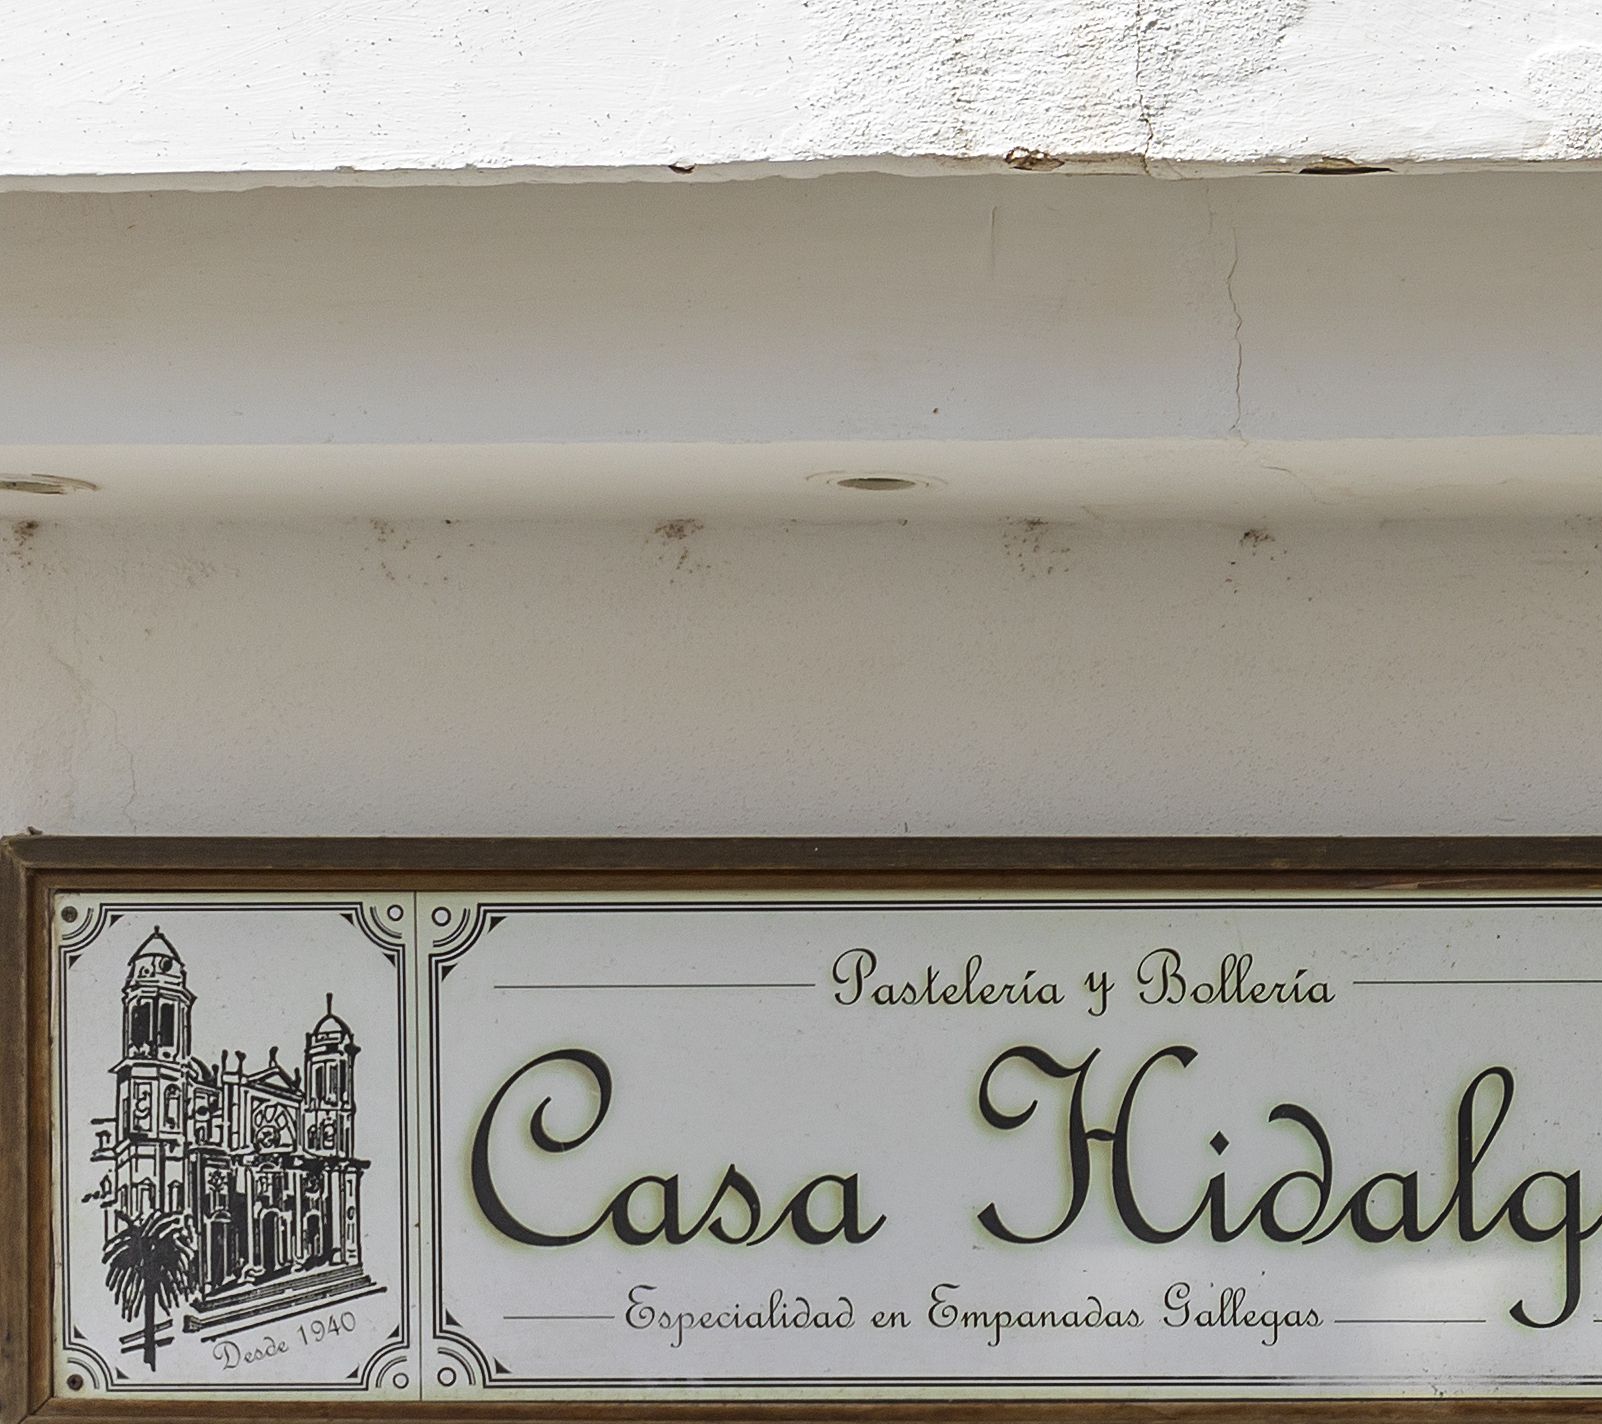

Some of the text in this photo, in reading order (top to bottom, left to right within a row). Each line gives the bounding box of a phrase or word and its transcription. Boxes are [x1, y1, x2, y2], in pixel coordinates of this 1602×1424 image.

[832, 947, 1336, 1017] Pastelería y Bollería
[470, 1047, 888, 1248] Casa
[213, 1310, 357, 1370] Desde 1940
[625, 1282, 1324, 1348] Especialidad en Empanadas Gallegas
